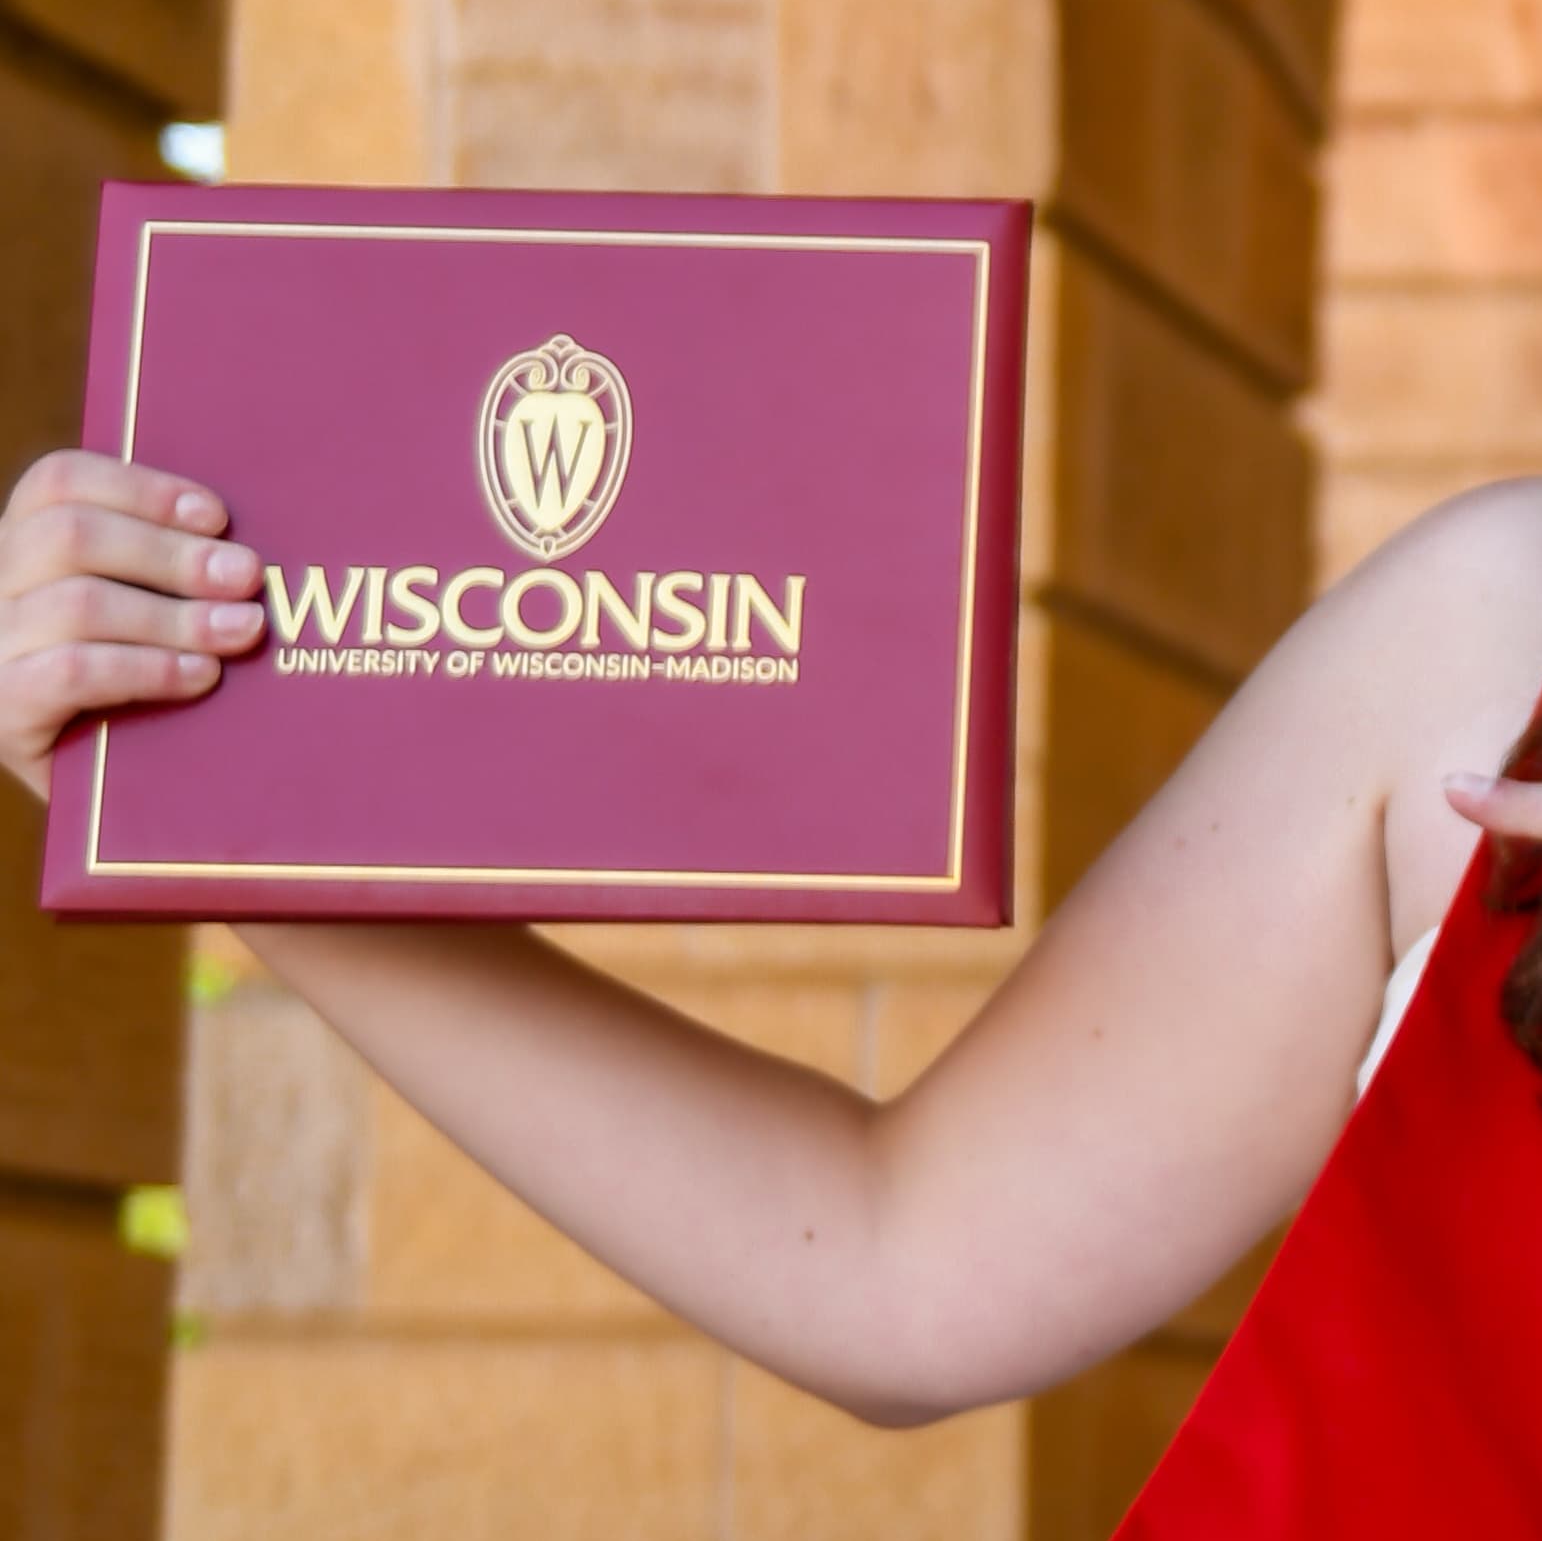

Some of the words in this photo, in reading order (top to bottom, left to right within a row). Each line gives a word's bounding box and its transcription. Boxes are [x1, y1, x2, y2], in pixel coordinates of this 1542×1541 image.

[519, 413, 593, 511] W
[264, 564, 807, 655] WISCONSIN
[277, 647, 441, 676] UNIVERSITY
[446, 651, 486, 678] OF
